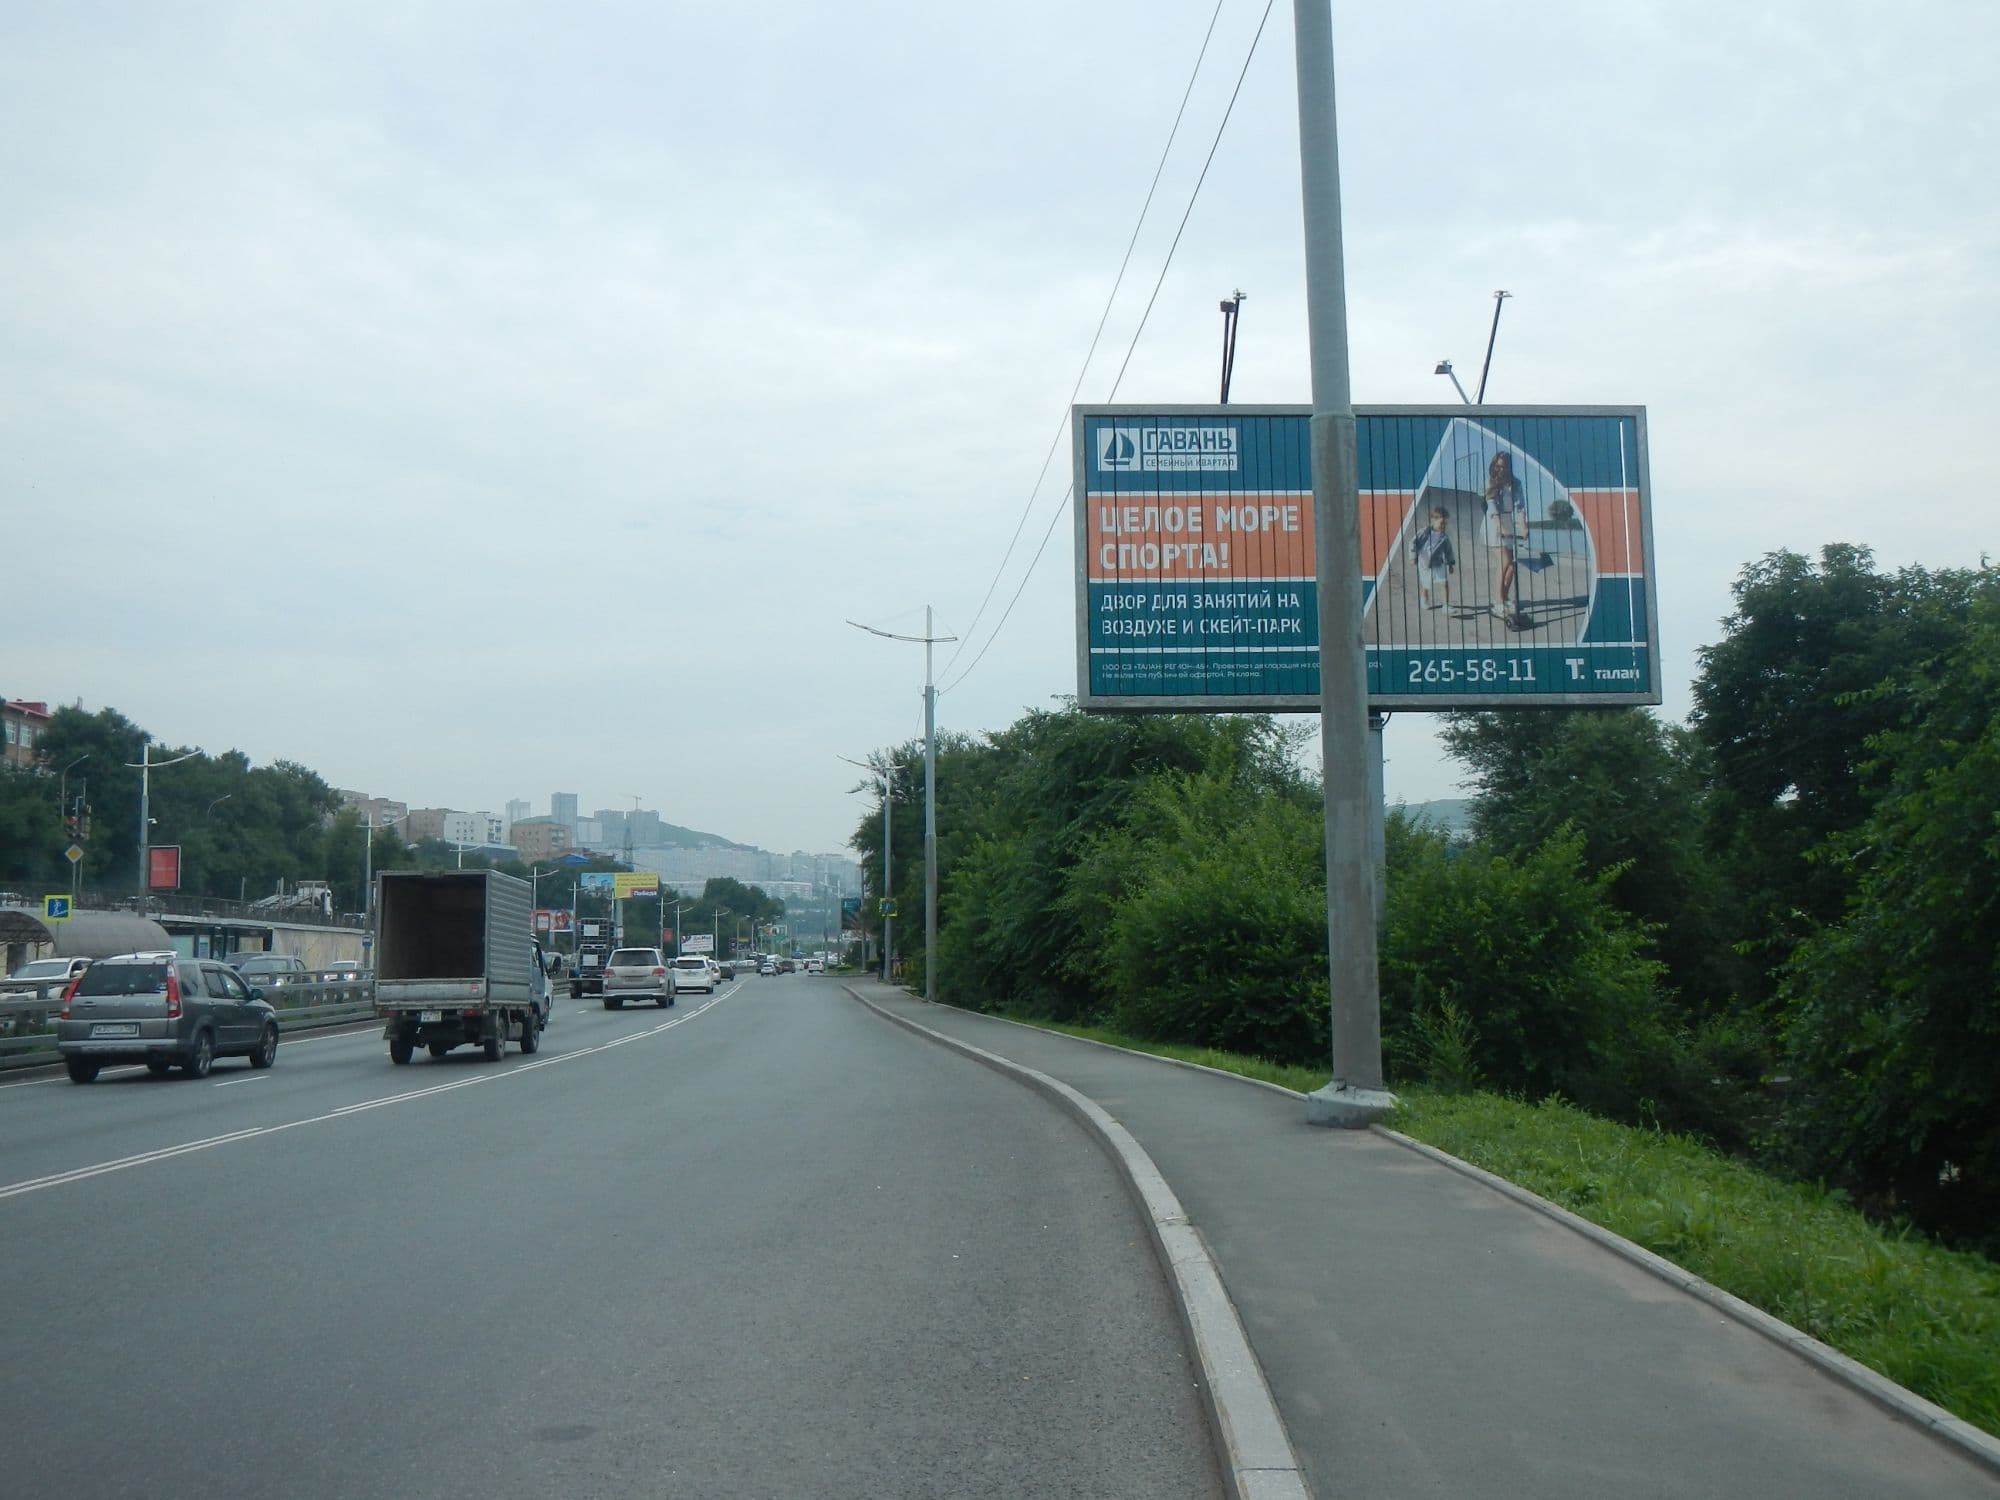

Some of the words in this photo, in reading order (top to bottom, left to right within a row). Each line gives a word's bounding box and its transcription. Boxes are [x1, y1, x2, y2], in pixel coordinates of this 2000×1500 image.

[1146, 431, 1233, 450] ГАВАНЬ
[1146, 455, 1194, 467] СЕМЕЙНЫЙ
[1196, 456, 1234, 467] КВАРТАЛ
[1101, 505, 1202, 537] ЦЕЛОЕ
[1216, 505, 1299, 532] МОРЕ
[1101, 542, 1230, 570] СПОРТА!
[1101, 594, 1147, 612] ДВОР
[1152, 594, 1188, 612] ДЛЯ
[1193, 590, 1272, 610] ЗАНЯТИЙ
[1278, 593, 1301, 609] НА
[1102, 619, 1177, 637] ВОЗДУХЕ
[1183, 619, 1194, 634] И
[1200, 615, 1301, 634] СКЕЙТ-ПАРК
[1408, 658, 1537, 683] 265-58-11
